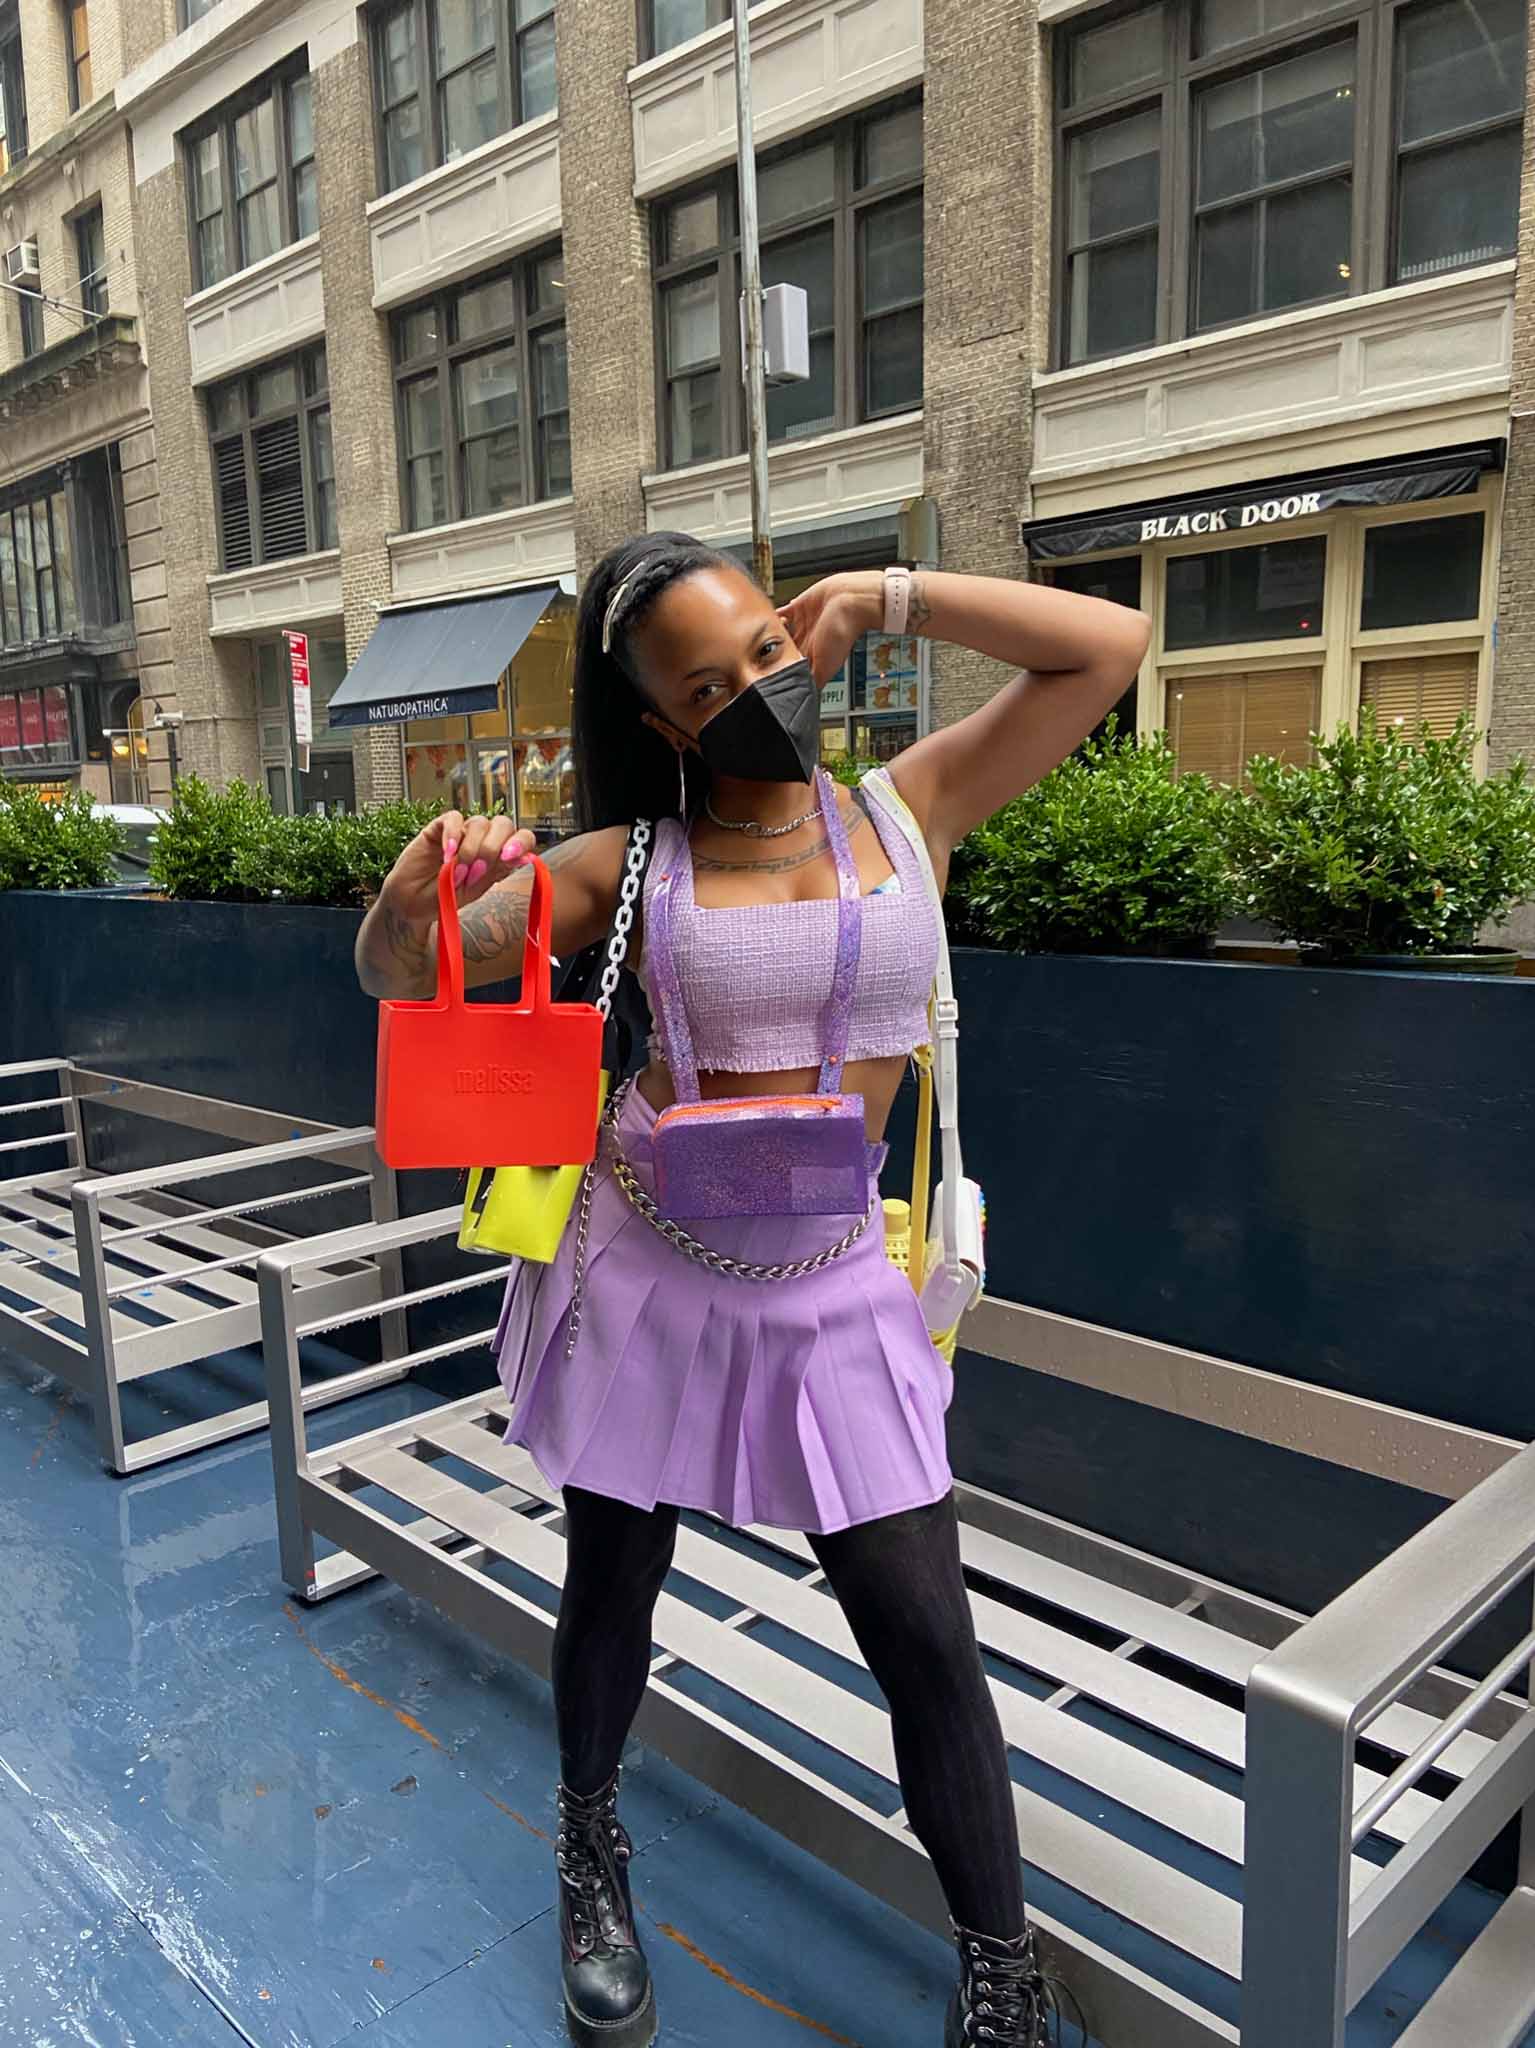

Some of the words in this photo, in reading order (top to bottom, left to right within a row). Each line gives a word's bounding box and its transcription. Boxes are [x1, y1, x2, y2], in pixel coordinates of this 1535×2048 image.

[1139, 508, 1228, 542] BLACK
[1240, 493, 1321, 528] DOOR
[368, 697, 448, 719] NATUROPATHICA
[455, 1063, 535, 1096] melissa
